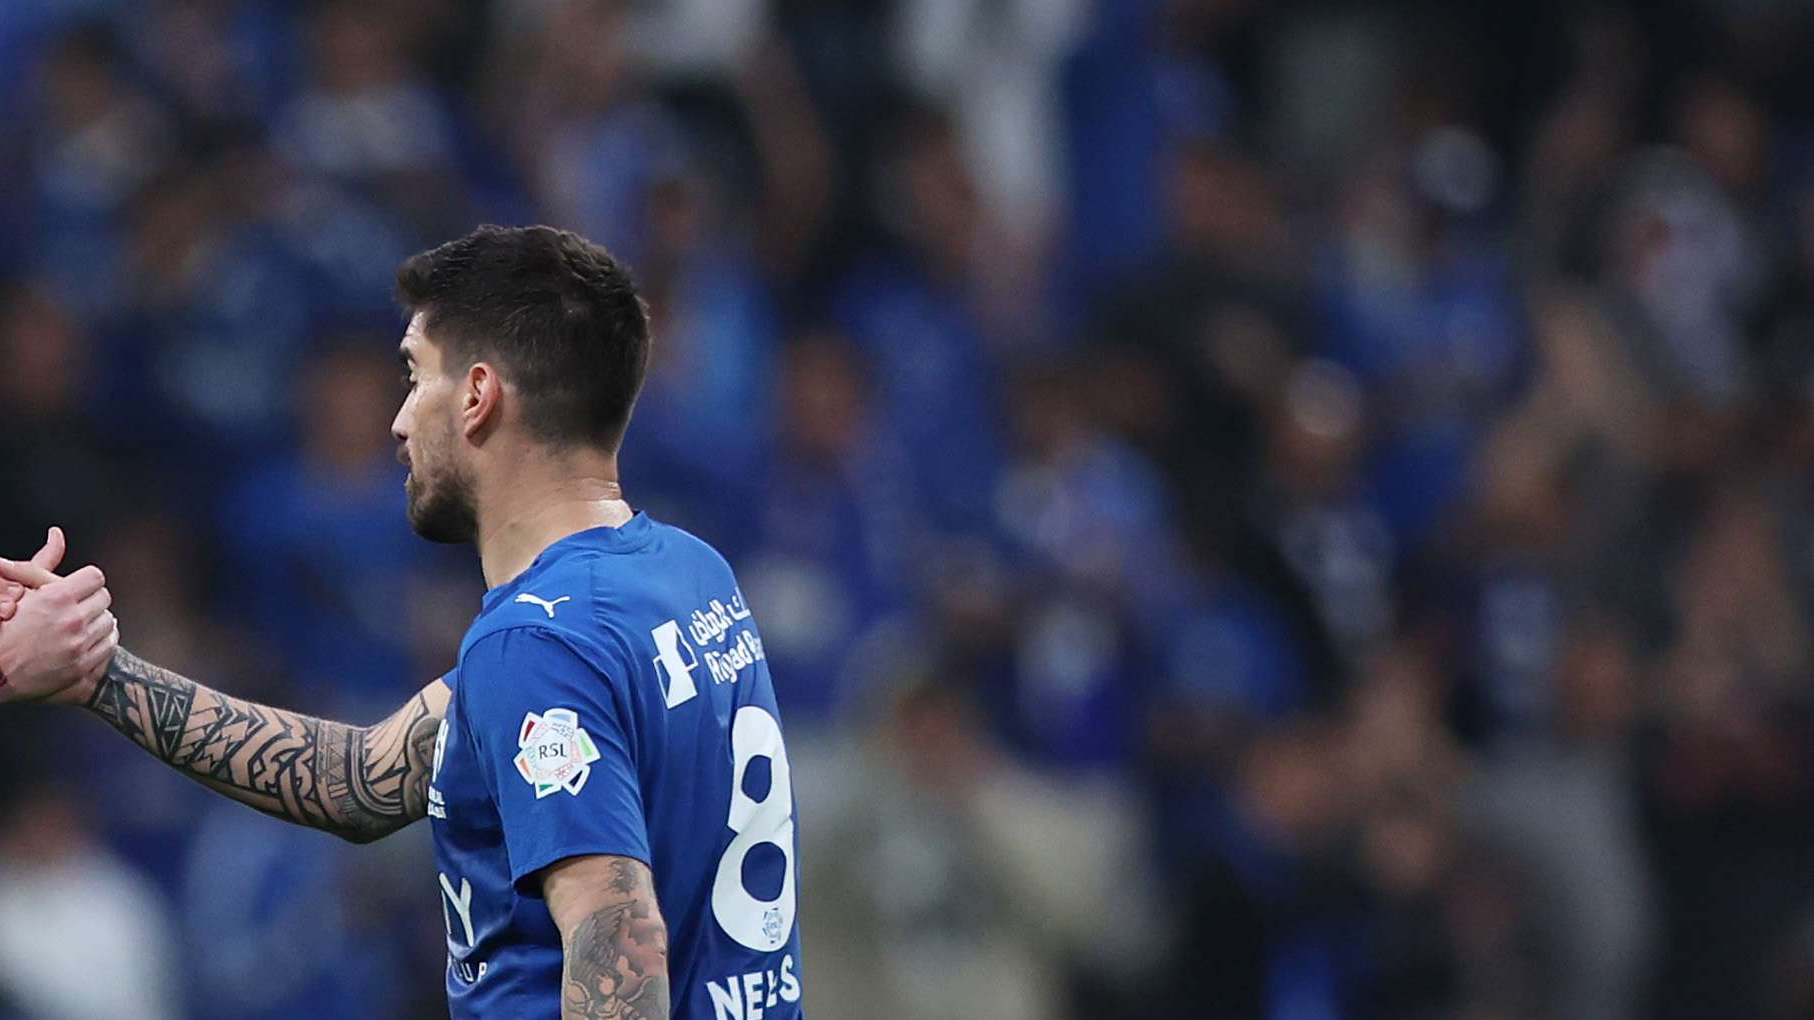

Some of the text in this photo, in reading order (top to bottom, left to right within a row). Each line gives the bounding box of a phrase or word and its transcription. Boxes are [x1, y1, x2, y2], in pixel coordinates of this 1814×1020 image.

[703, 634, 754, 685] Riyad
[538, 742, 568, 760] RSL
[711, 705, 796, 953] 8
